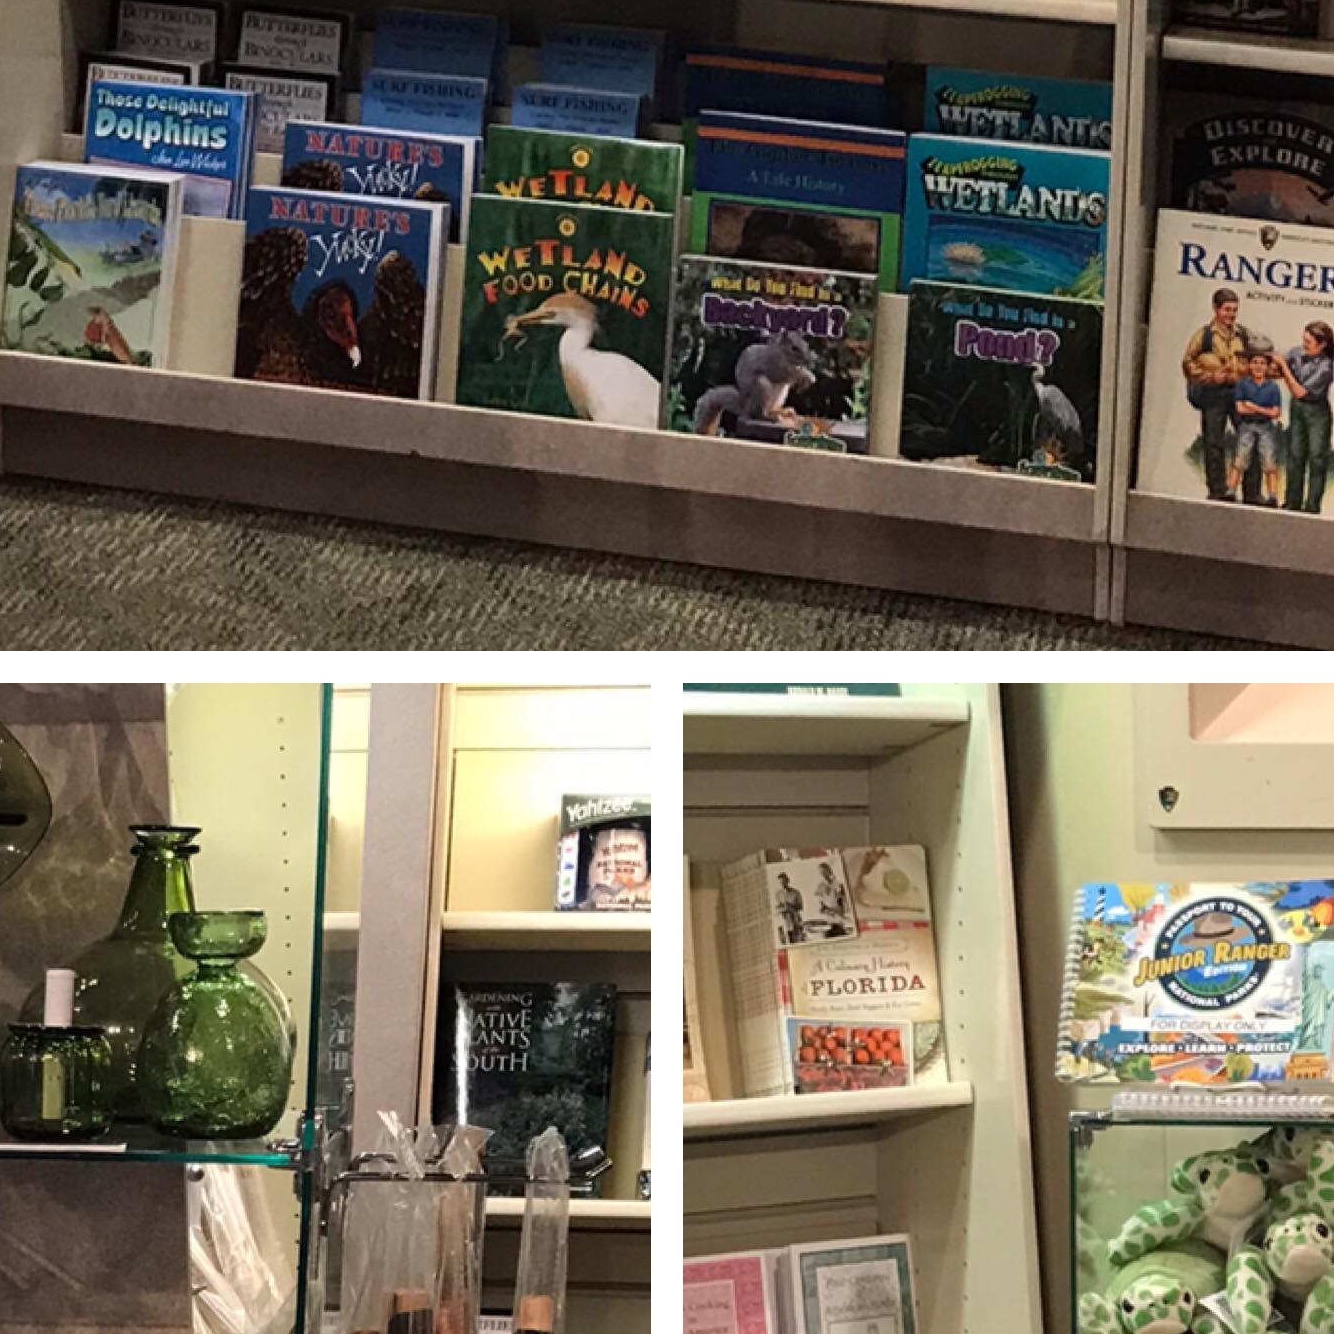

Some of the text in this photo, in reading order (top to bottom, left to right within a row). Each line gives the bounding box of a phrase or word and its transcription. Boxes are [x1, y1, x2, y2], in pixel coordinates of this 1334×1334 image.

[97, 88, 230, 118] Those Delightful
[94, 108, 227, 152] Dolphins
[306, 130, 444, 167] NATURE'S
[1203, 119, 1334, 154] DISCOVER
[1211, 143, 1327, 179] EXPLORE
[269, 196, 411, 233] NATURE'S
[924, 174, 1107, 226] WETLANDS
[478, 239, 647, 286] WETLAND
[701, 293, 850, 338] Backyard?
[955, 320, 1060, 365] Pond?
[1134, 941, 1291, 986] JUNIOR RANGER
[809, 973, 926, 997] FLORIDA
[1150, 1020, 1266, 1031] FOR DISPLAY ONLY
[1119, 1041, 1291, 1053] EXPLORE LEARN PROTECT
